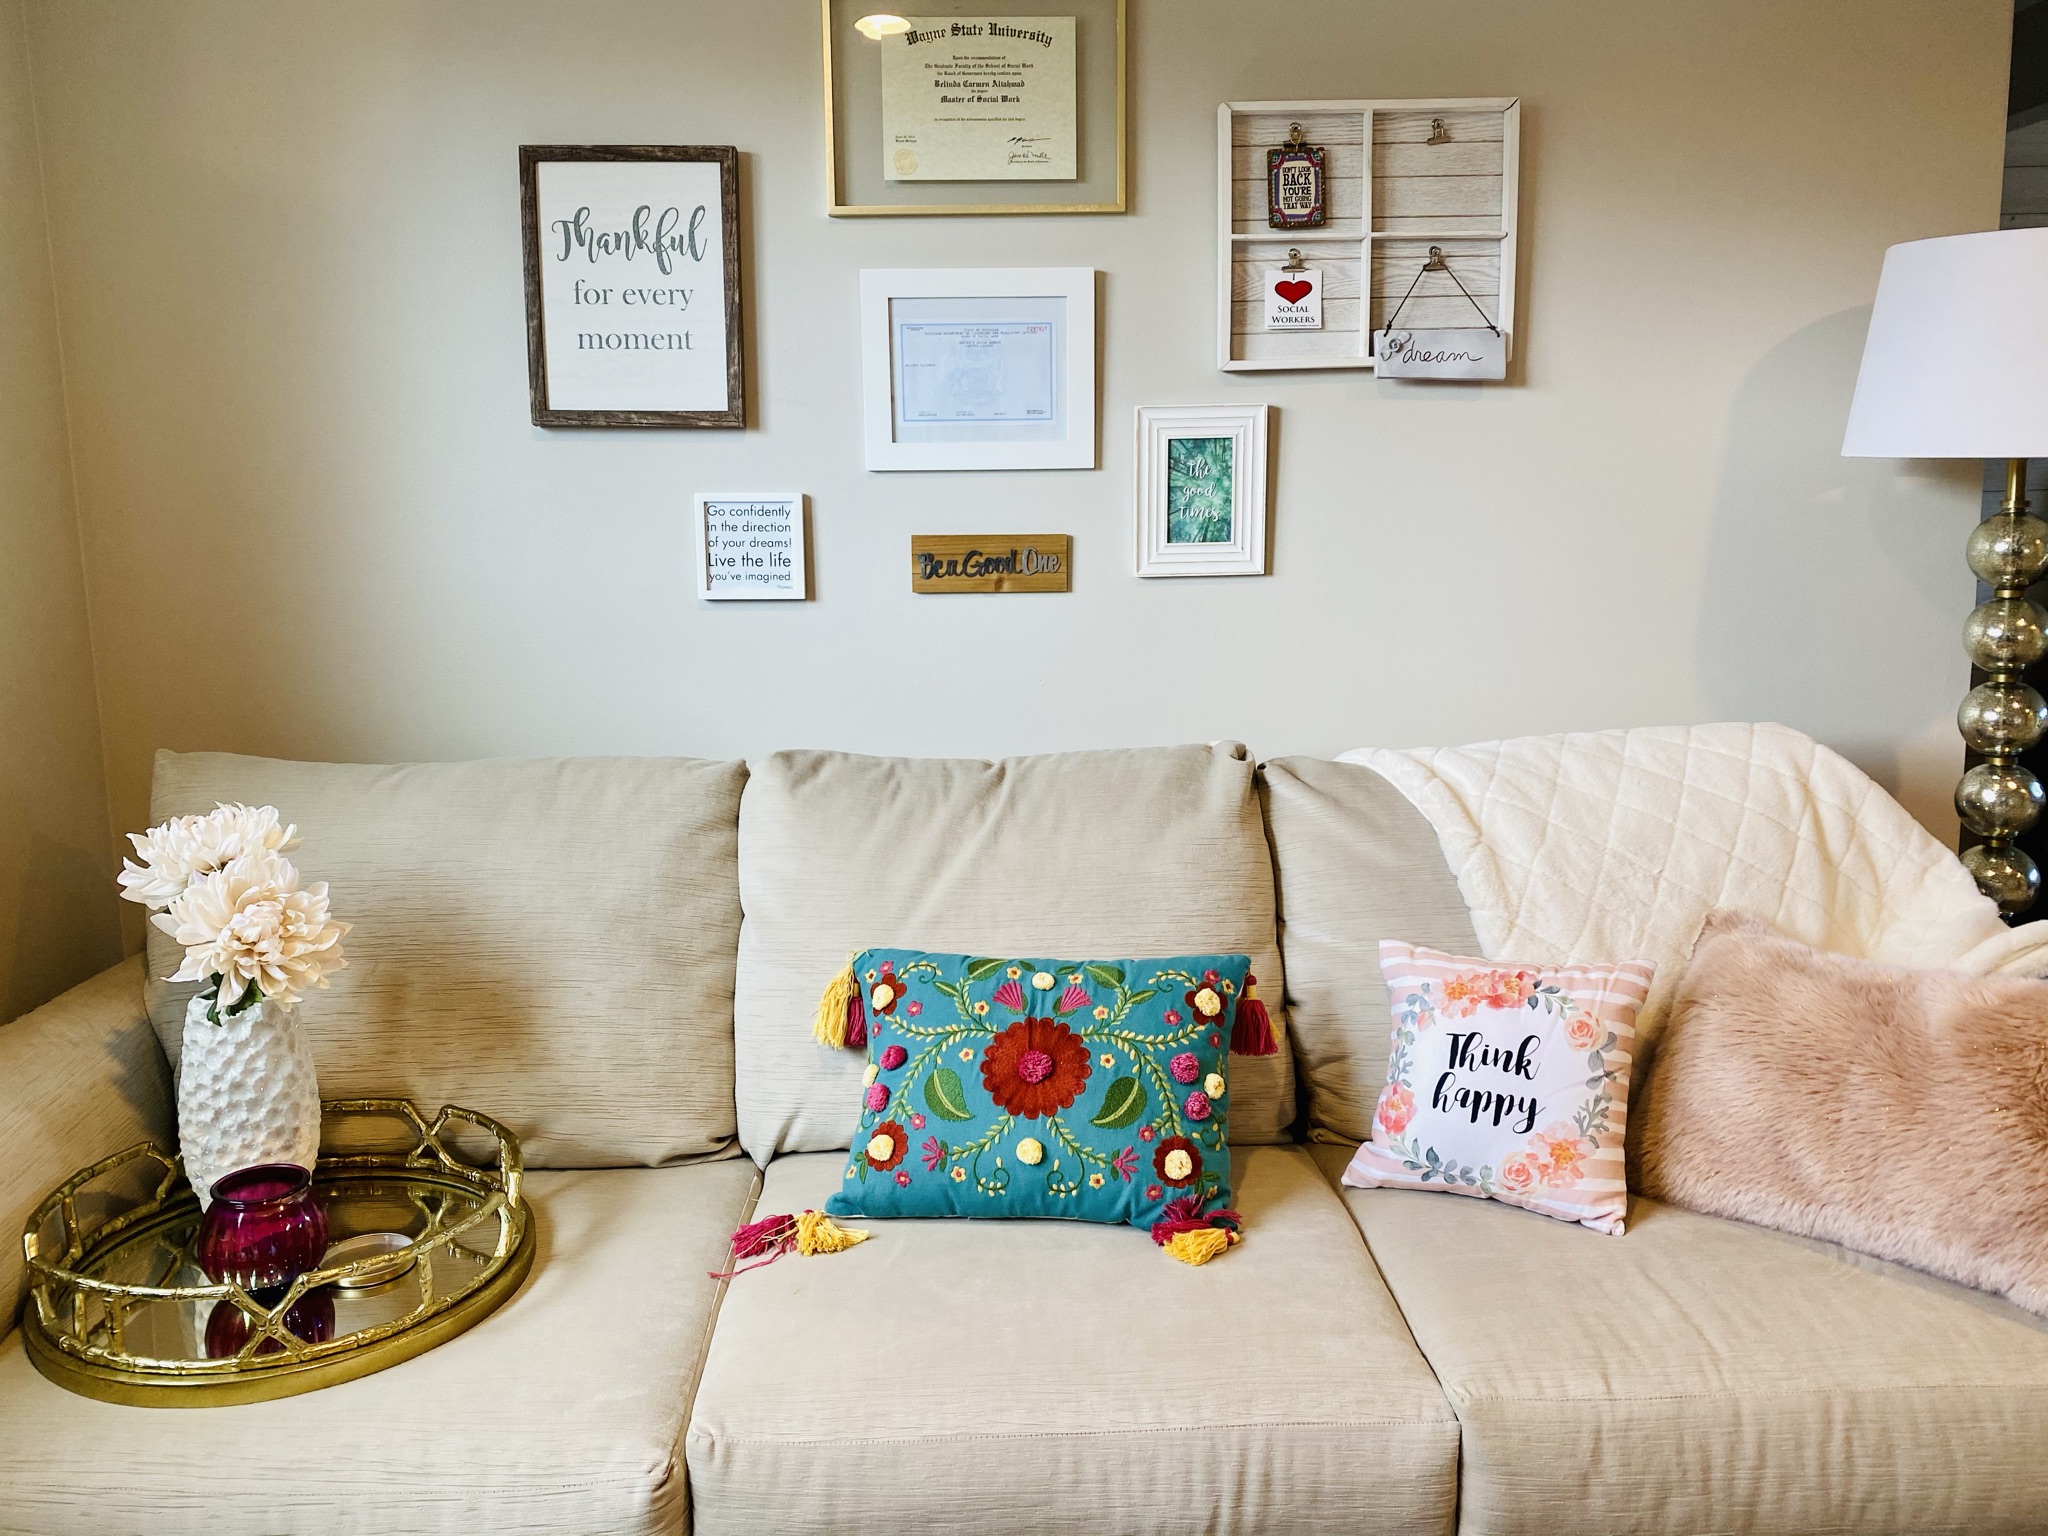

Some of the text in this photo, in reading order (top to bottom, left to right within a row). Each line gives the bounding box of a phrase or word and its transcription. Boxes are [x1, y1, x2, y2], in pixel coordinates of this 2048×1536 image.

[904, 22, 1053, 48] Wayne State University
[934, 80, 961, 88] Belinda
[962, 80, 990, 88] Carmen
[940, 94, 1021, 103] Master of Social Work
[1282, 172, 1312, 186] BACK
[1282, 186, 1312, 196] YOU'RE
[551, 205, 708, 276] Thankful
[573, 279, 694, 311] for every
[1277, 305, 1310, 313] SOCIAL
[577, 329, 695, 351] moment
[1402, 340, 1484, 363] dream
[1186, 457, 1213, 479] the
[1183, 482, 1216, 503] good
[707, 505, 791, 520] Go confidently
[1180, 504, 1220, 522] times
[707, 520, 791, 532] in the direction
[708, 536, 792, 550] of your dreams!
[708, 551, 791, 567] Live the life
[918, 552, 945, 580] Be
[962, 548, 1023, 578] Good
[1021, 546, 1062, 576] One
[709, 571, 741, 583] you've
[1446, 1031, 1542, 1081] Think
[1431, 1071, 1546, 1134] happy
